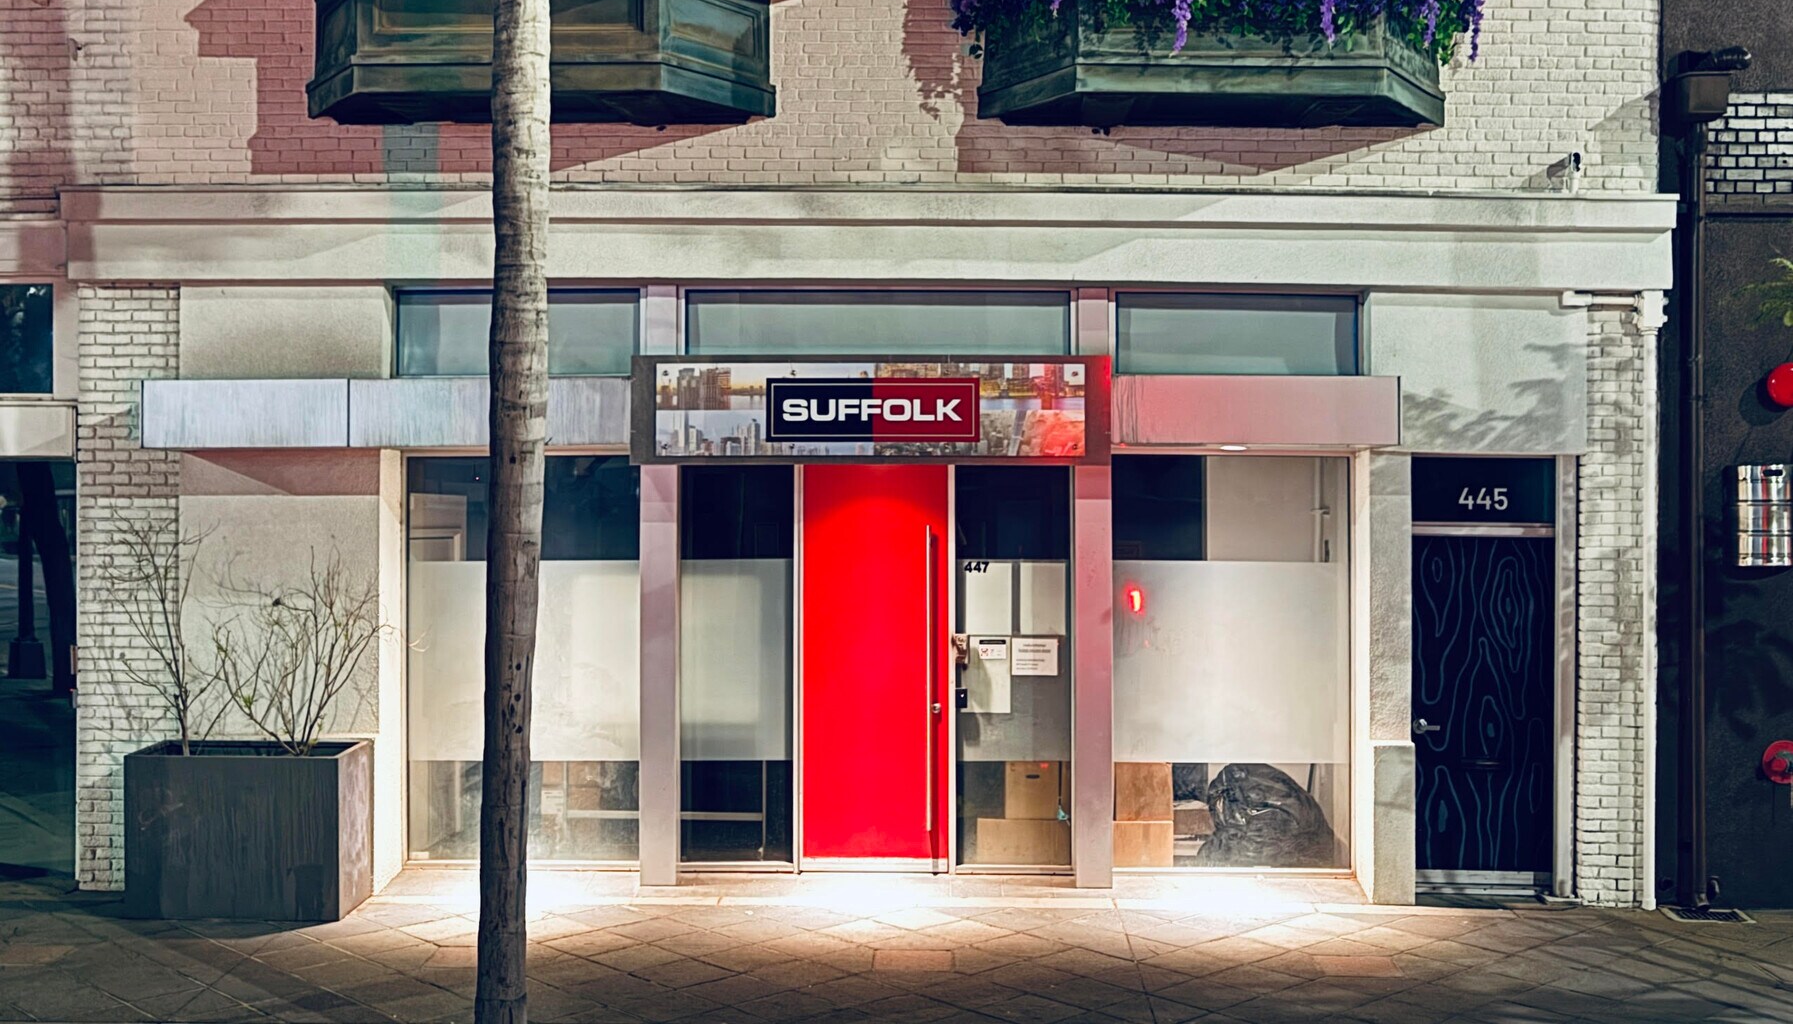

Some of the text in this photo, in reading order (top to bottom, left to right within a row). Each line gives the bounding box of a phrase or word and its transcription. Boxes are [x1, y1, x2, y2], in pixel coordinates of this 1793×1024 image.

[782, 398, 963, 422] SUFFOLK
[1458, 487, 1509, 511] 445
[963, 561, 990, 574] 447
